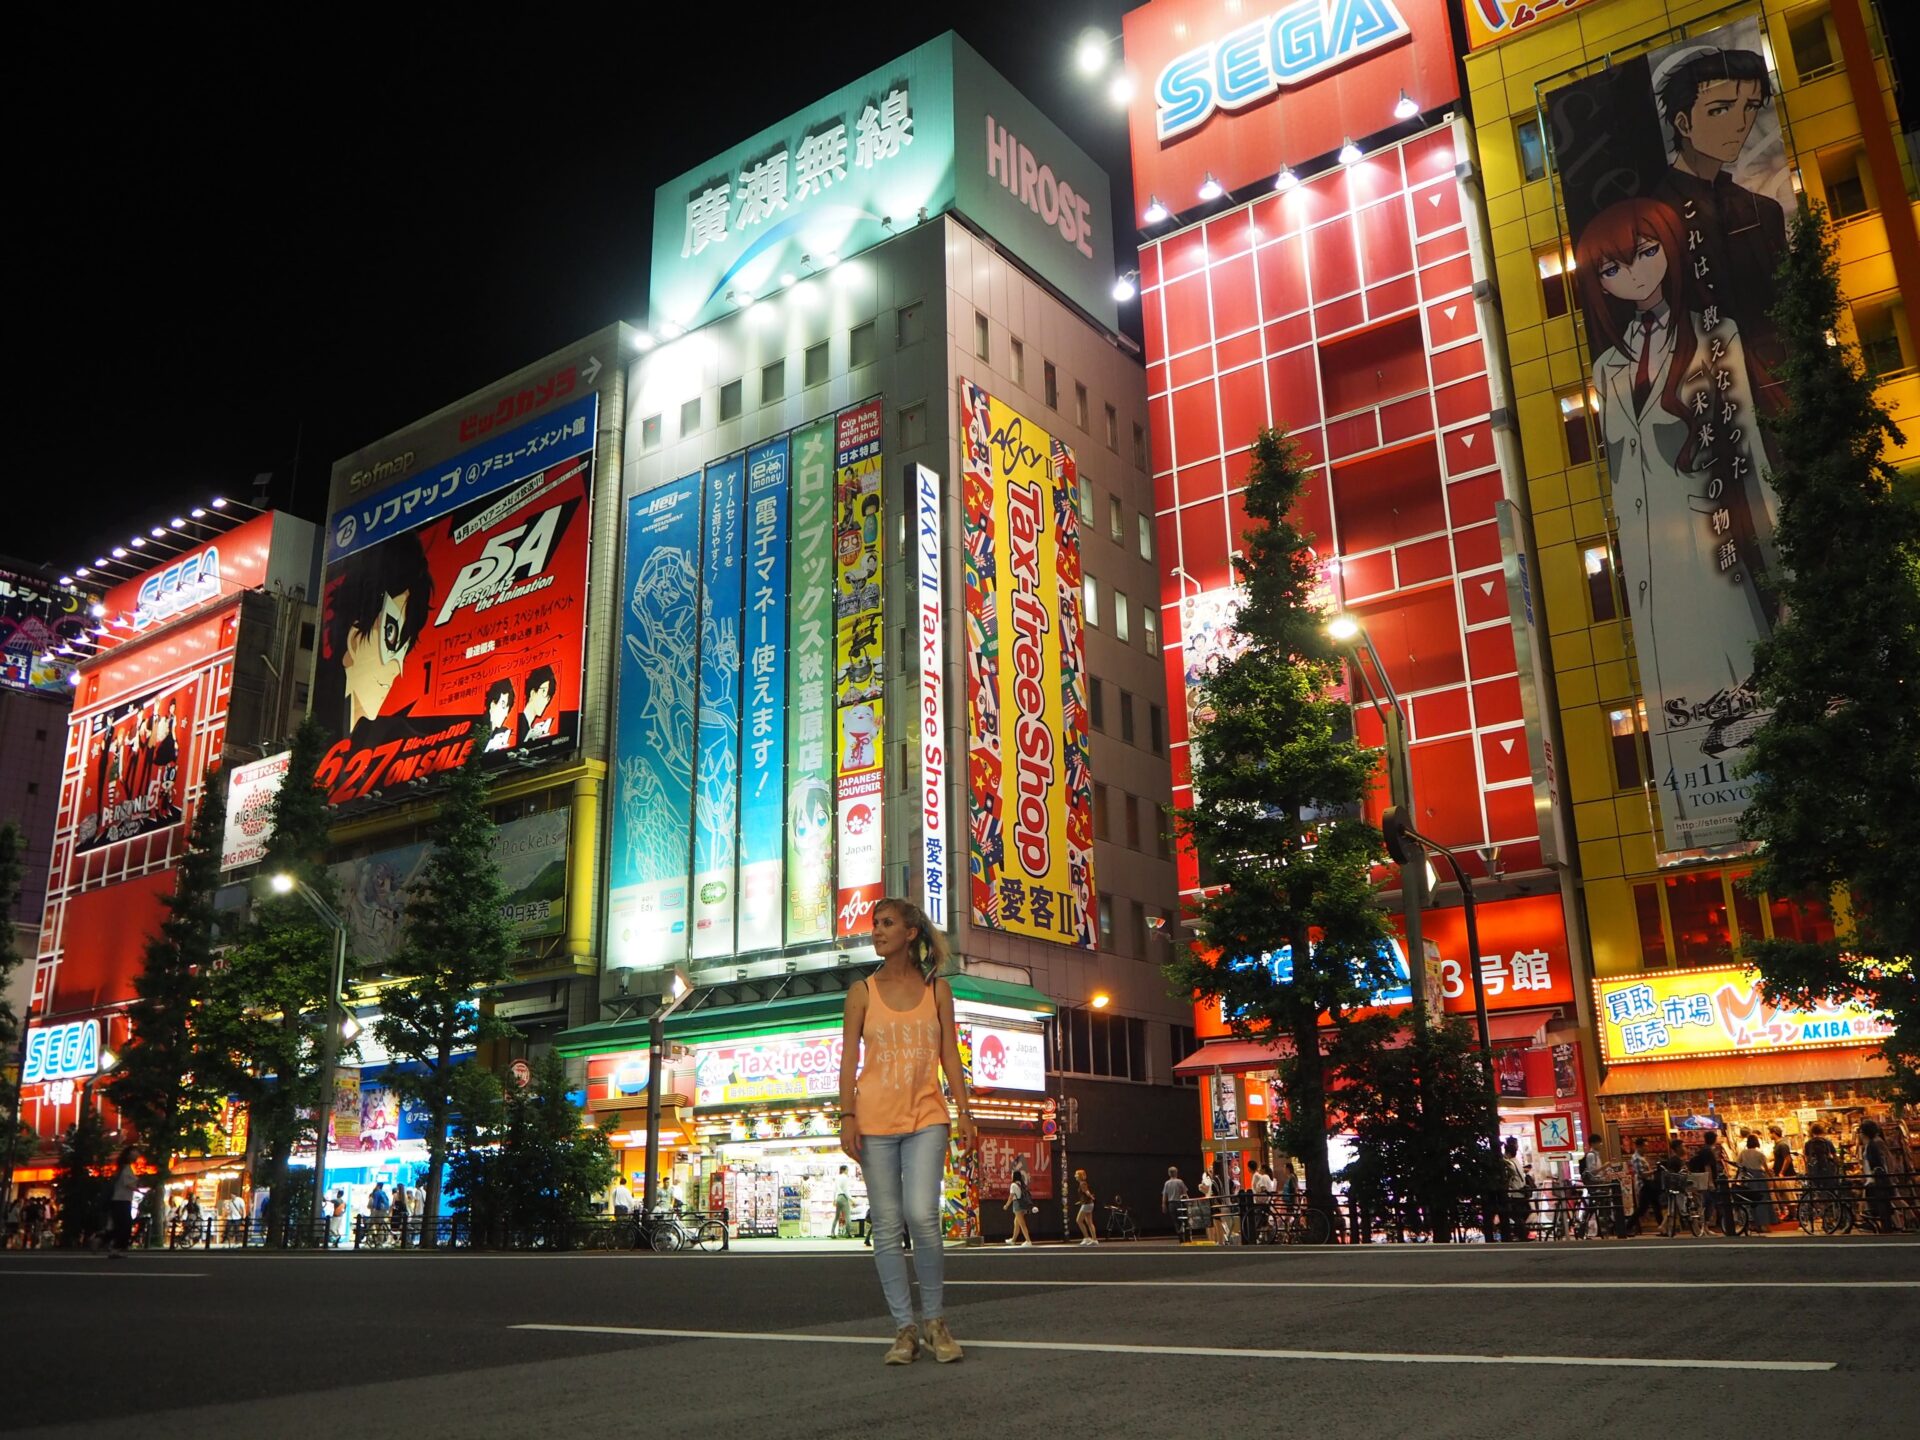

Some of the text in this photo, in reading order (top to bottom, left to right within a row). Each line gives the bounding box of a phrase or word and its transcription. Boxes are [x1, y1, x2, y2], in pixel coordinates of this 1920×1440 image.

[1510, 0, 1579, 28] ムー
[1155, 0, 1411, 141] SEGA
[985, 113, 1093, 259] HIROSE
[457, 365, 577, 443] ビックカメラ
[349, 450, 415, 493] Sofmap
[362, 467, 462, 532] ソフマップ
[648, 491, 678, 516] Hey
[723, 472, 737, 568] ゲームセンターを
[920, 471, 938, 568] AKKY
[134, 546, 222, 633] SEGA
[475, 575, 554, 613] the Animation
[797, 433, 828, 771] メロンブックス秋葉原店
[922, 602, 940, 736] Tax-free
[1008, 482, 1053, 875] Tax-free Shop
[384, 738, 477, 787] ON SALE
[837, 770, 882, 788] JAPANESE
[1663, 760, 1730, 792] 4月11
[837, 781, 882, 799] SOUVENIR
[924, 743, 943, 830] Shop
[234, 810, 249, 825] BIG
[1676, 814, 1740, 832] http://steinsg
[237, 845, 260, 863] APPLE
[502, 831, 557, 856] Pockets
[1442, 947, 1552, 998] 3号館
[1606, 986, 1654, 1020] 買取
[1663, 997, 1712, 1027] 市場
[23, 1019, 100, 1083] SEGA
[1624, 1019, 1667, 1053] 販売
[1736, 1024, 1799, 1046] ムーラン
[1802, 1021, 1850, 1040] AKIBA
[876, 1047, 937, 1064] KEY WEST
[981, 1138, 1050, 1172] 貸ホール
